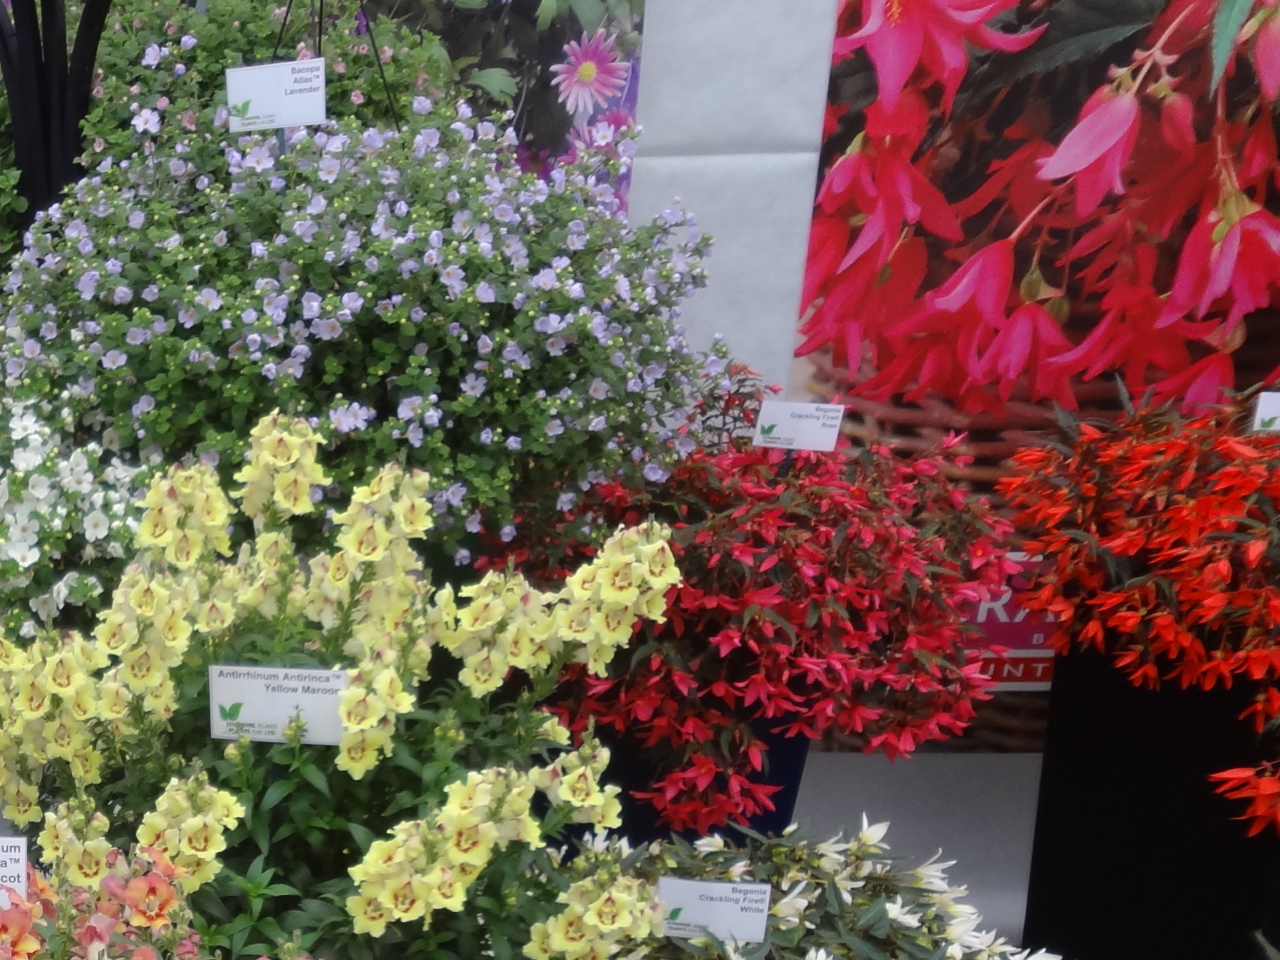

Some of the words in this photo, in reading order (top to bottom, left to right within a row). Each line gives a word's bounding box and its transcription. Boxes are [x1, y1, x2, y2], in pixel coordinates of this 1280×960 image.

[290, 66, 320, 75] Bacopa
[284, 85, 321, 96] Lavender
[217, 670, 279, 682] Antirrhinum
[264, 683, 298, 694] Yellow
[731, 886, 767, 896] Begonia
[699, 894, 741, 905] Crackling
[740, 906, 765, 914] White
